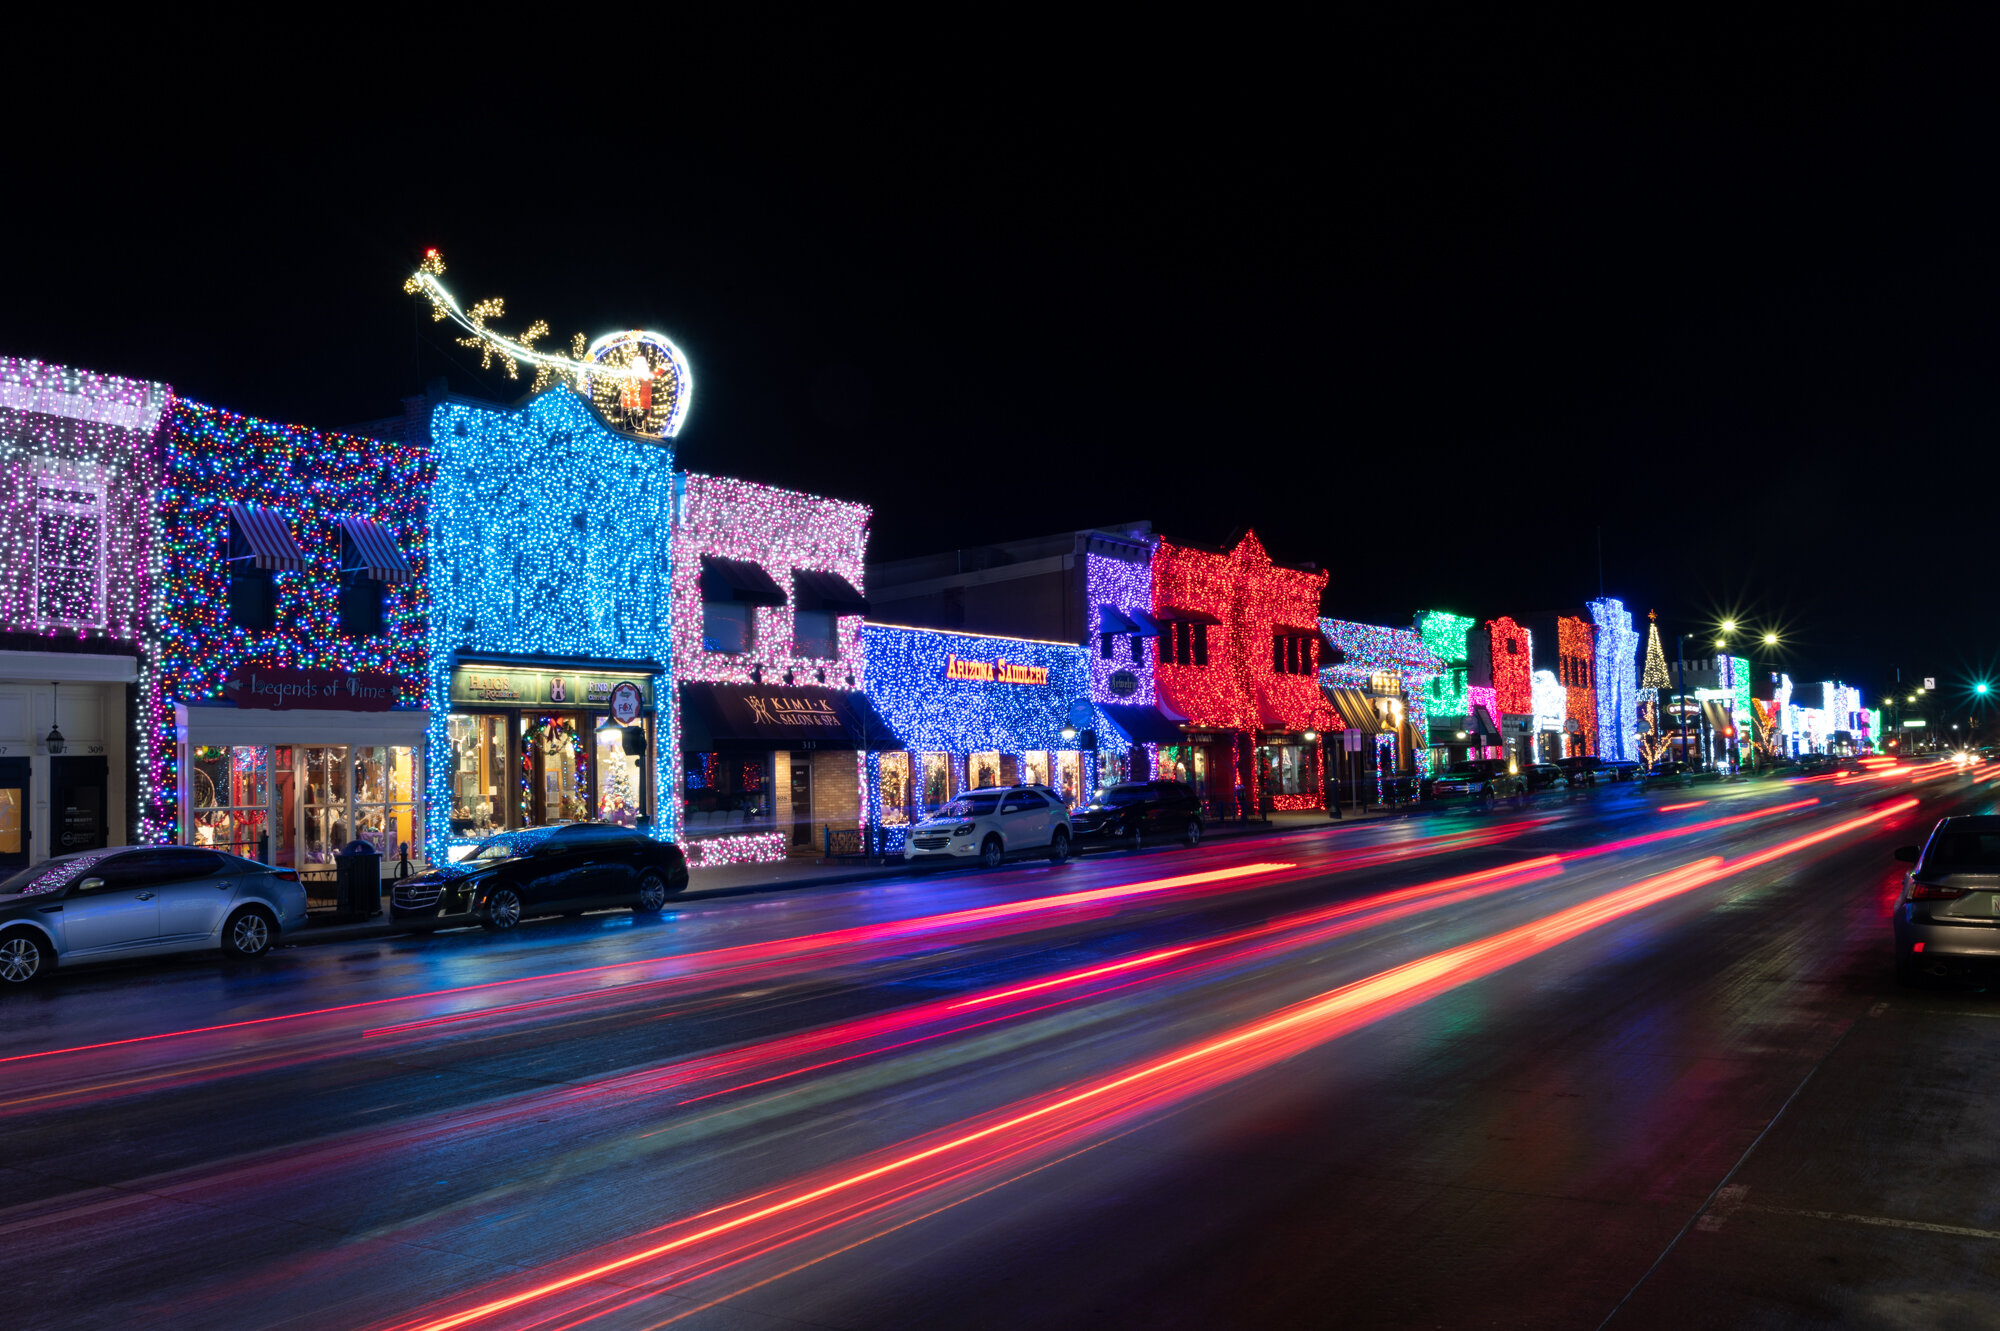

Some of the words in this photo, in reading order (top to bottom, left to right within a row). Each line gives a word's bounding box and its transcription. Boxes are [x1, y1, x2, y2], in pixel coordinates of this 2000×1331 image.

[250, 673, 317, 706] Legends
[323, 680, 339, 696] of
[346, 677, 385, 698] Time
[588, 681, 608, 692] FINE
[780, 714, 814, 725] SALON
[814, 715, 822, 725] &
[821, 715, 841, 726] SPA
[88, 745, 104, 754] 309
[802, 741, 816, 750] 313
